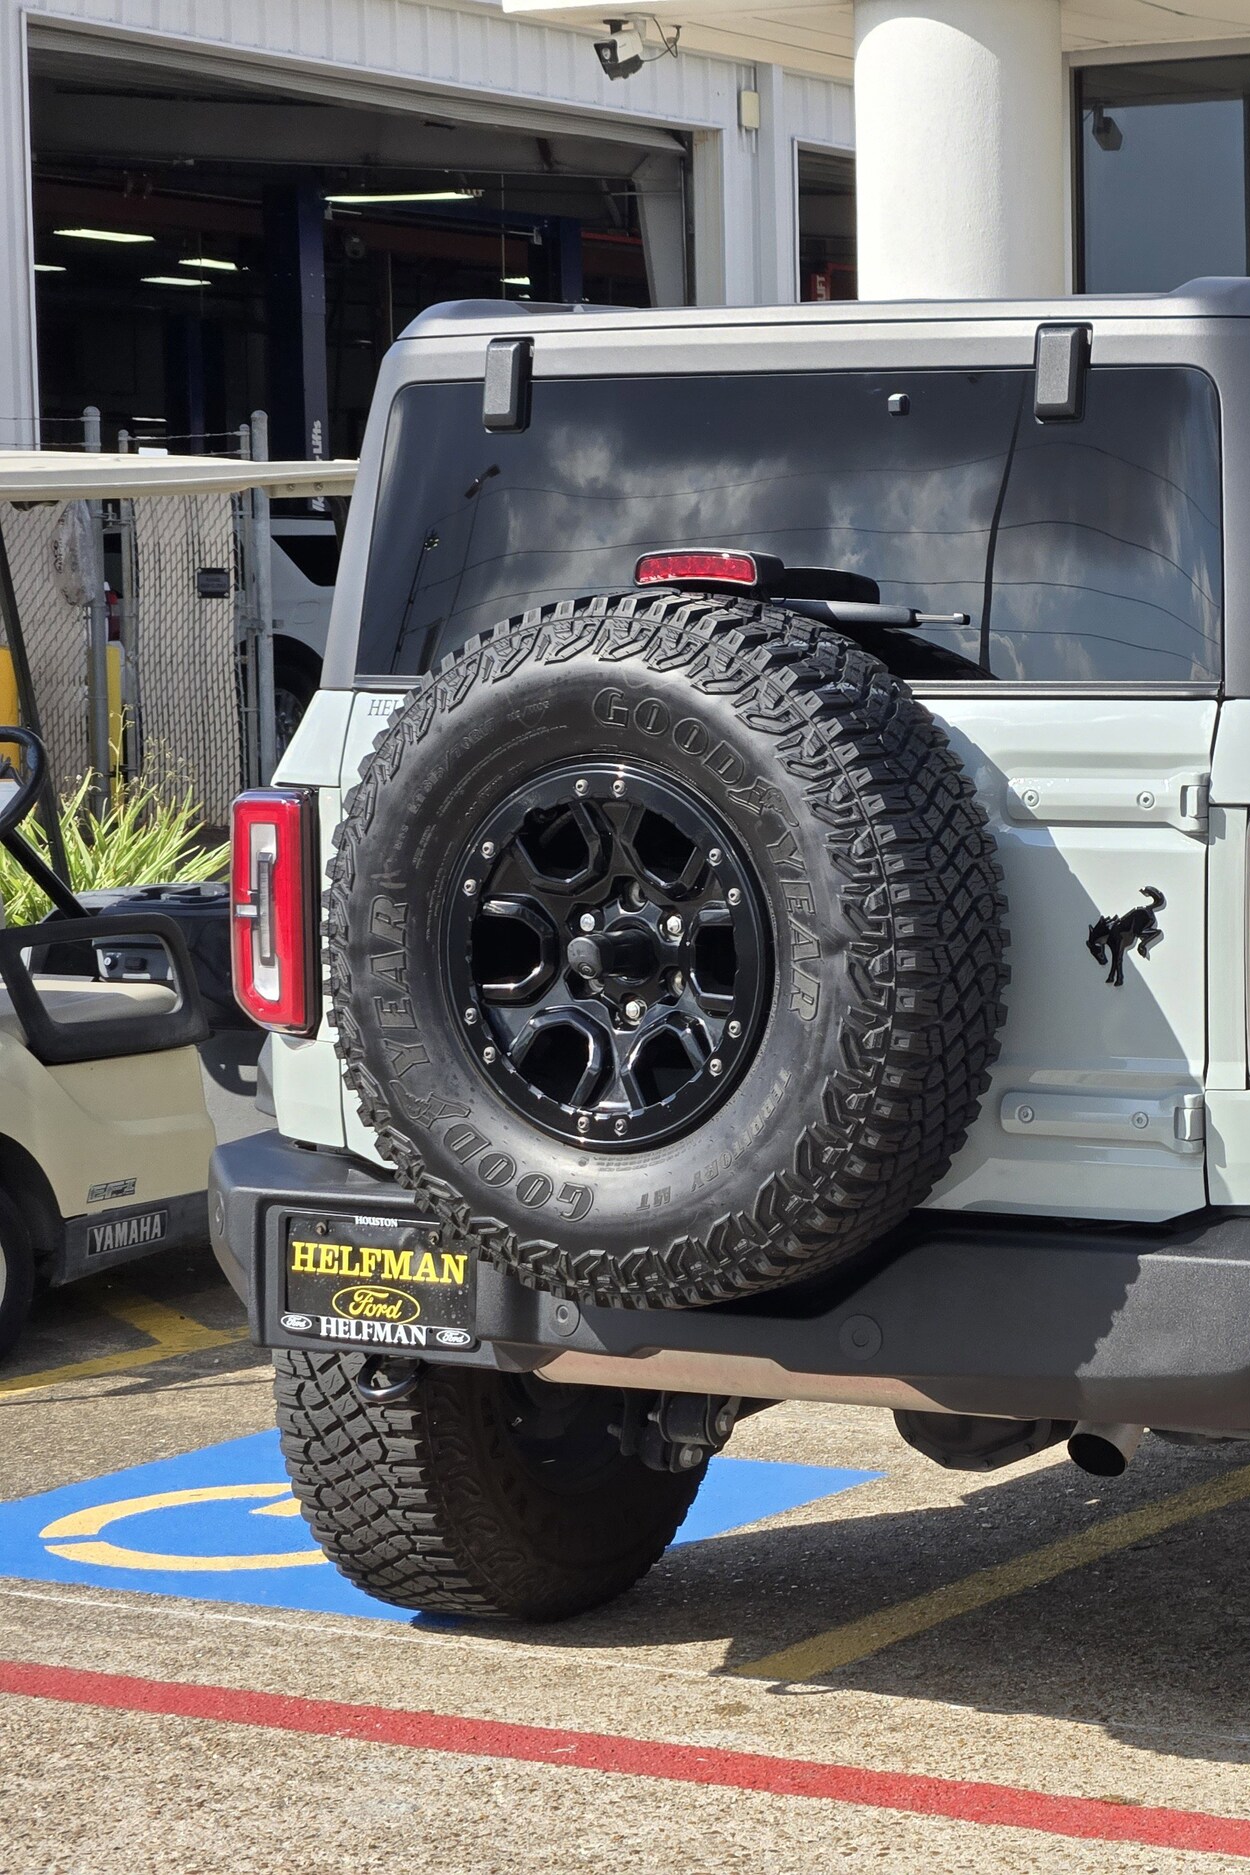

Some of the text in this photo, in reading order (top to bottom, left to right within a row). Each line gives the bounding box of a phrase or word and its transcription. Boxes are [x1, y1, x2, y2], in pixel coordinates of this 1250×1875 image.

[592, 686, 822, 1021] GOODYEAR
[369, 894, 594, 1222] GOODYEAR
[690, 1068, 793, 1192] TERRITORY
[636, 1186, 672, 1211] MT
[93, 1214, 162, 1253] YAMAHA
[354, 1216, 399, 1228] HOUSTON
[291, 1241, 469, 1285] HELFMAN
[348, 1289, 404, 1320] Ford
[319, 1317, 428, 1346] HELFMAN
